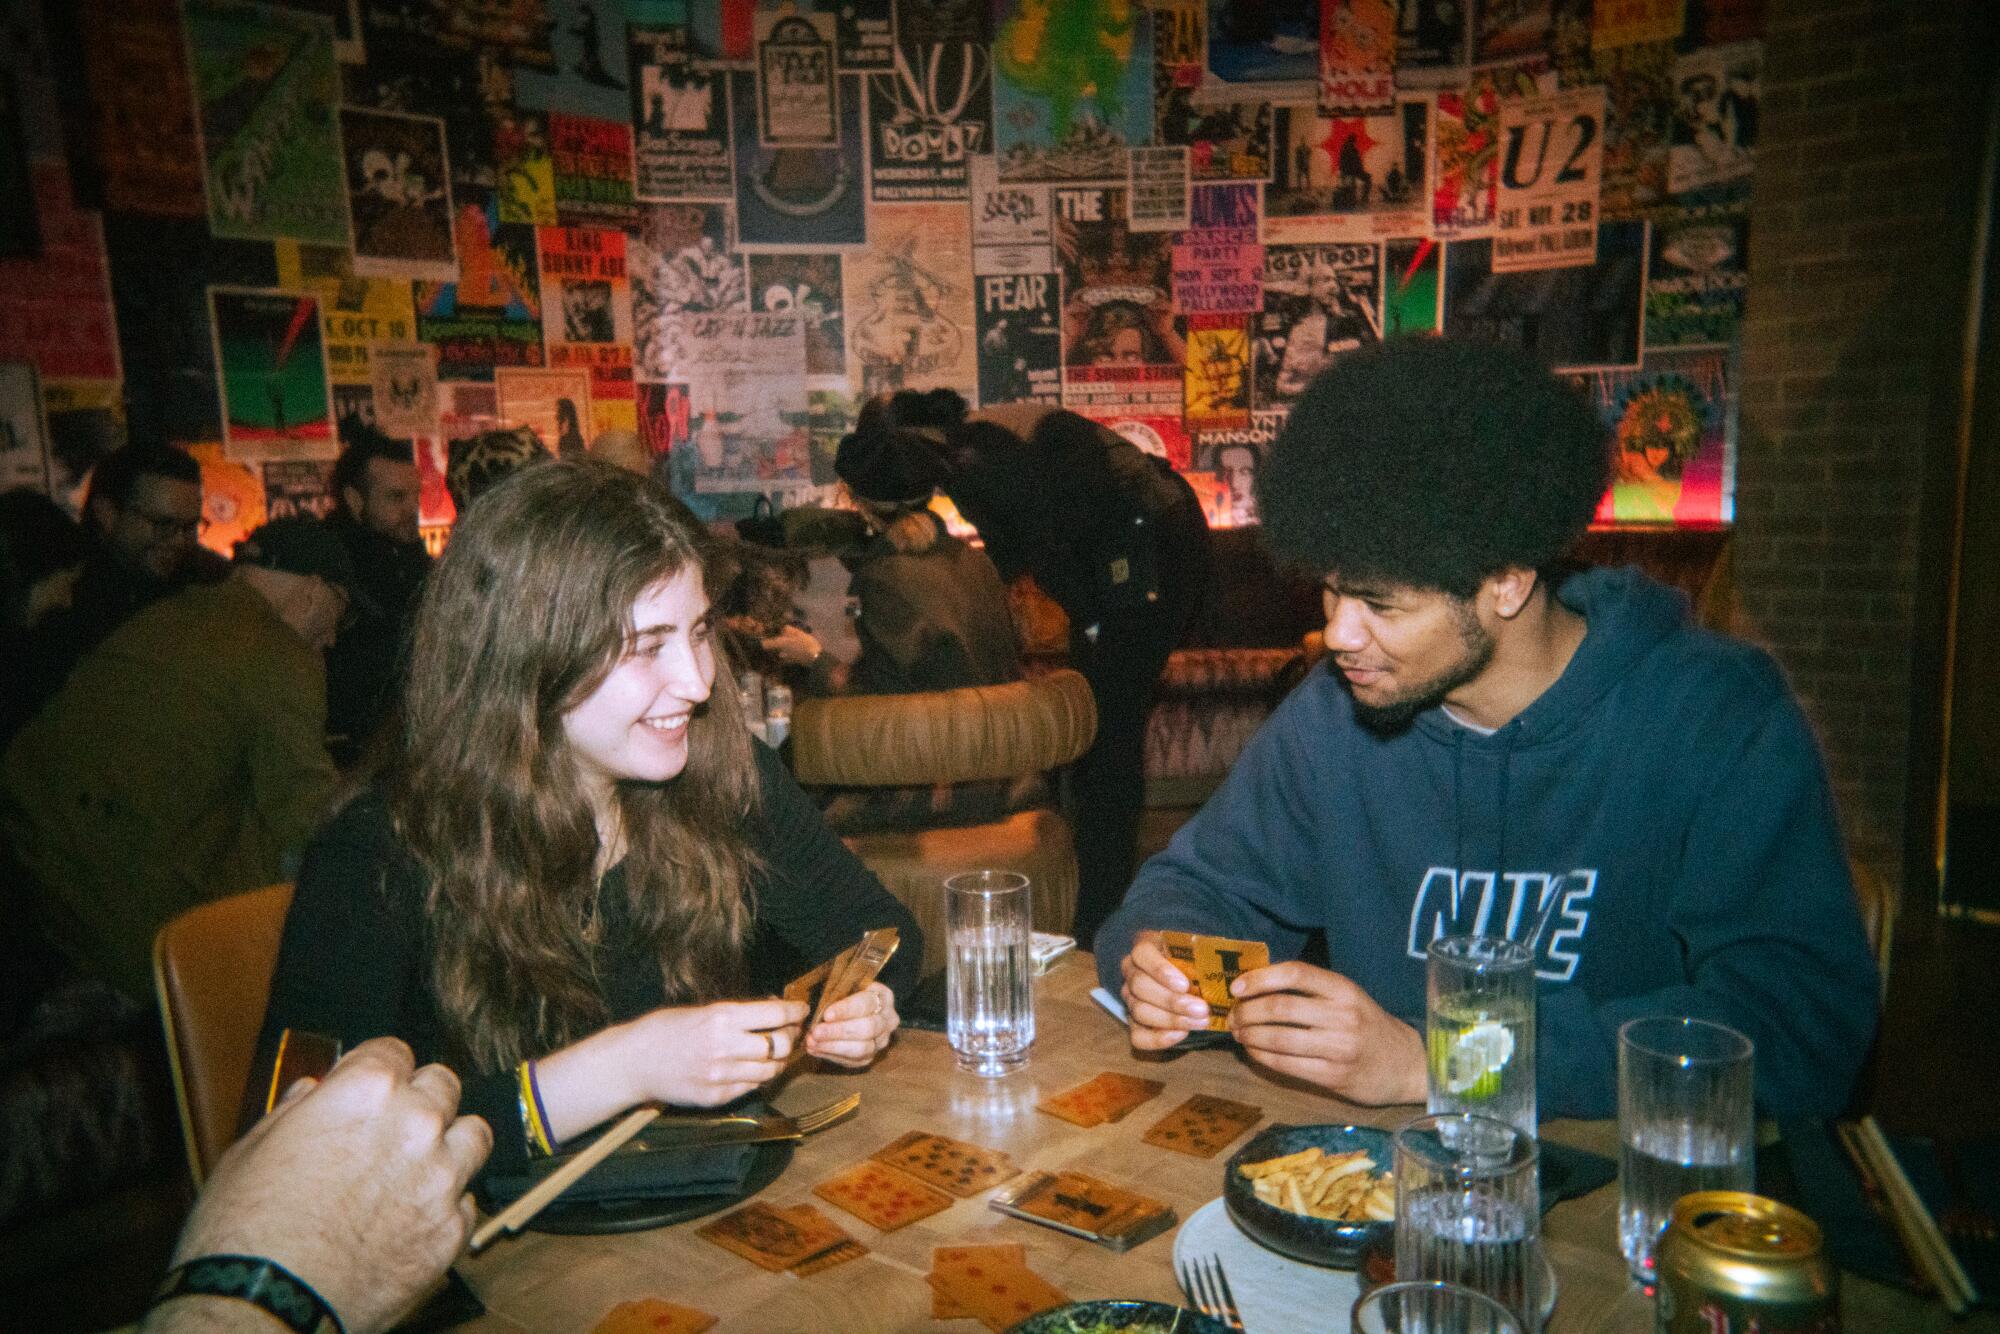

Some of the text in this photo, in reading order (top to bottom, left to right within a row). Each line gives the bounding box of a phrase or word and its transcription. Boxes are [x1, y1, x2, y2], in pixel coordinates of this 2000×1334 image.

[1326, 79, 1391, 98] HOLE
[1502, 114, 1596, 190] U2
[1057, 191, 1103, 222] THE
[1562, 201, 1592, 222] 28
[1193, 247, 1237, 259] PARTY
[1265, 248, 1371, 273] IGGY POP
[985, 276, 1047, 312] FEAR
[1178, 285, 1258, 298] HOLLYWOOD
[343, 318, 377, 338] OCT
[1199, 430, 1274, 446] MANSON
